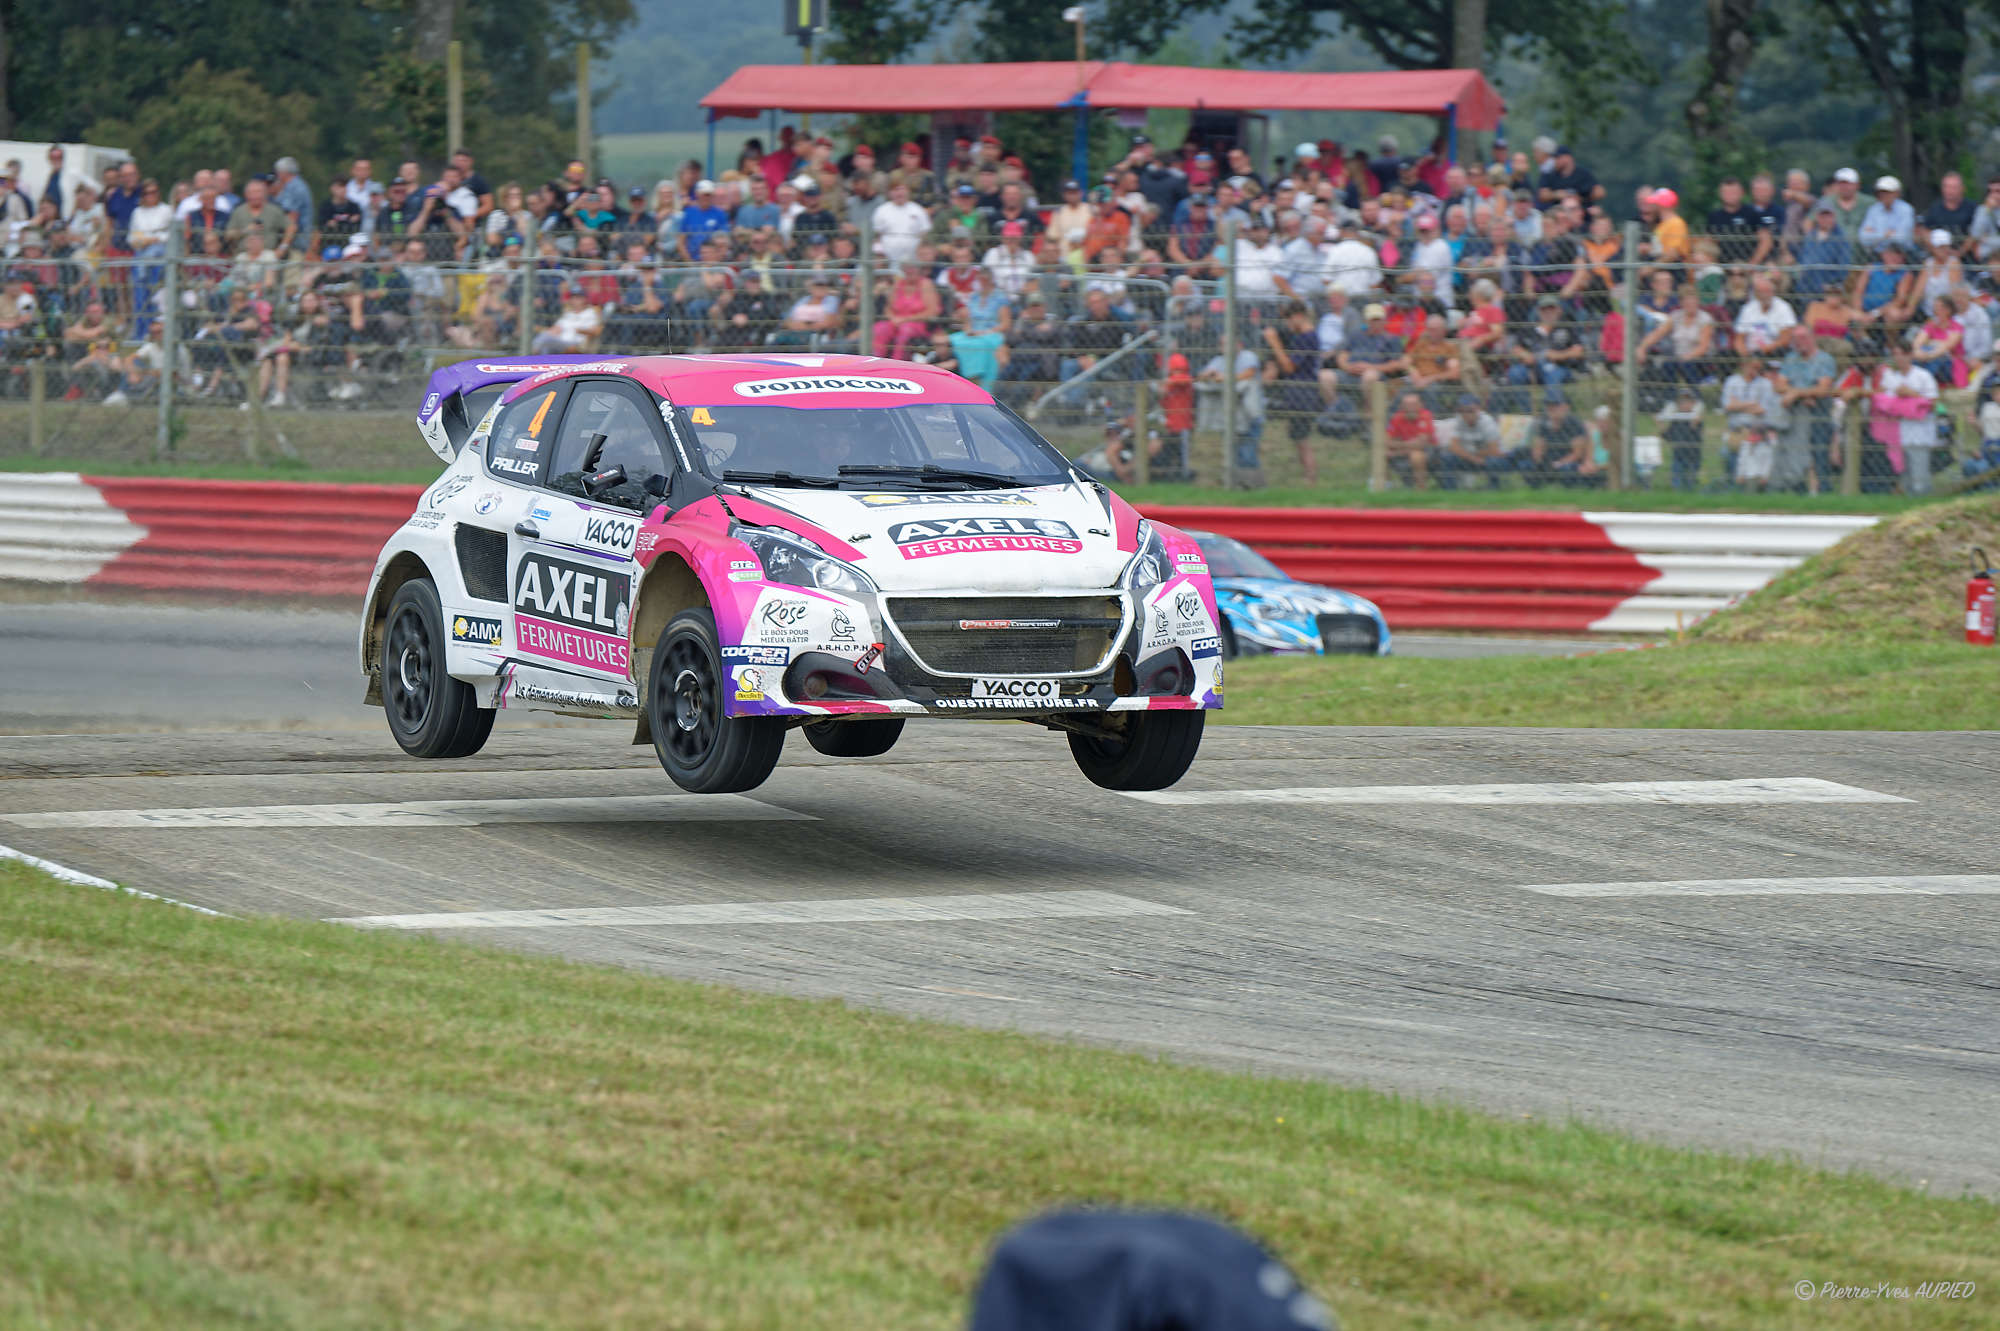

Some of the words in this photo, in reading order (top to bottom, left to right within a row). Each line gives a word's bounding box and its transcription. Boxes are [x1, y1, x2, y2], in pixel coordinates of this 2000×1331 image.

[747, 379, 911, 394] PODIOCOM
[528, 391, 557, 438] 4
[691, 408, 716, 425] 4
[919, 494, 1018, 503] AMY
[585, 517, 634, 549] YACCO
[896, 519, 1040, 542] AXEL
[907, 538, 1077, 556] FERMETURES
[515, 561, 614, 628] AXEL
[761, 599, 808, 628] Rose
[1175, 592, 1200, 620] Rose
[469, 621, 501, 640] AMY
[519, 621, 627, 668] FERMETURES
[721, 647, 788, 657] COOPER
[748, 655, 786, 665] TIRES
[982, 680, 1051, 696] YACCO
[935, 698, 1099, 708] OUESTFERMETURE.FR
